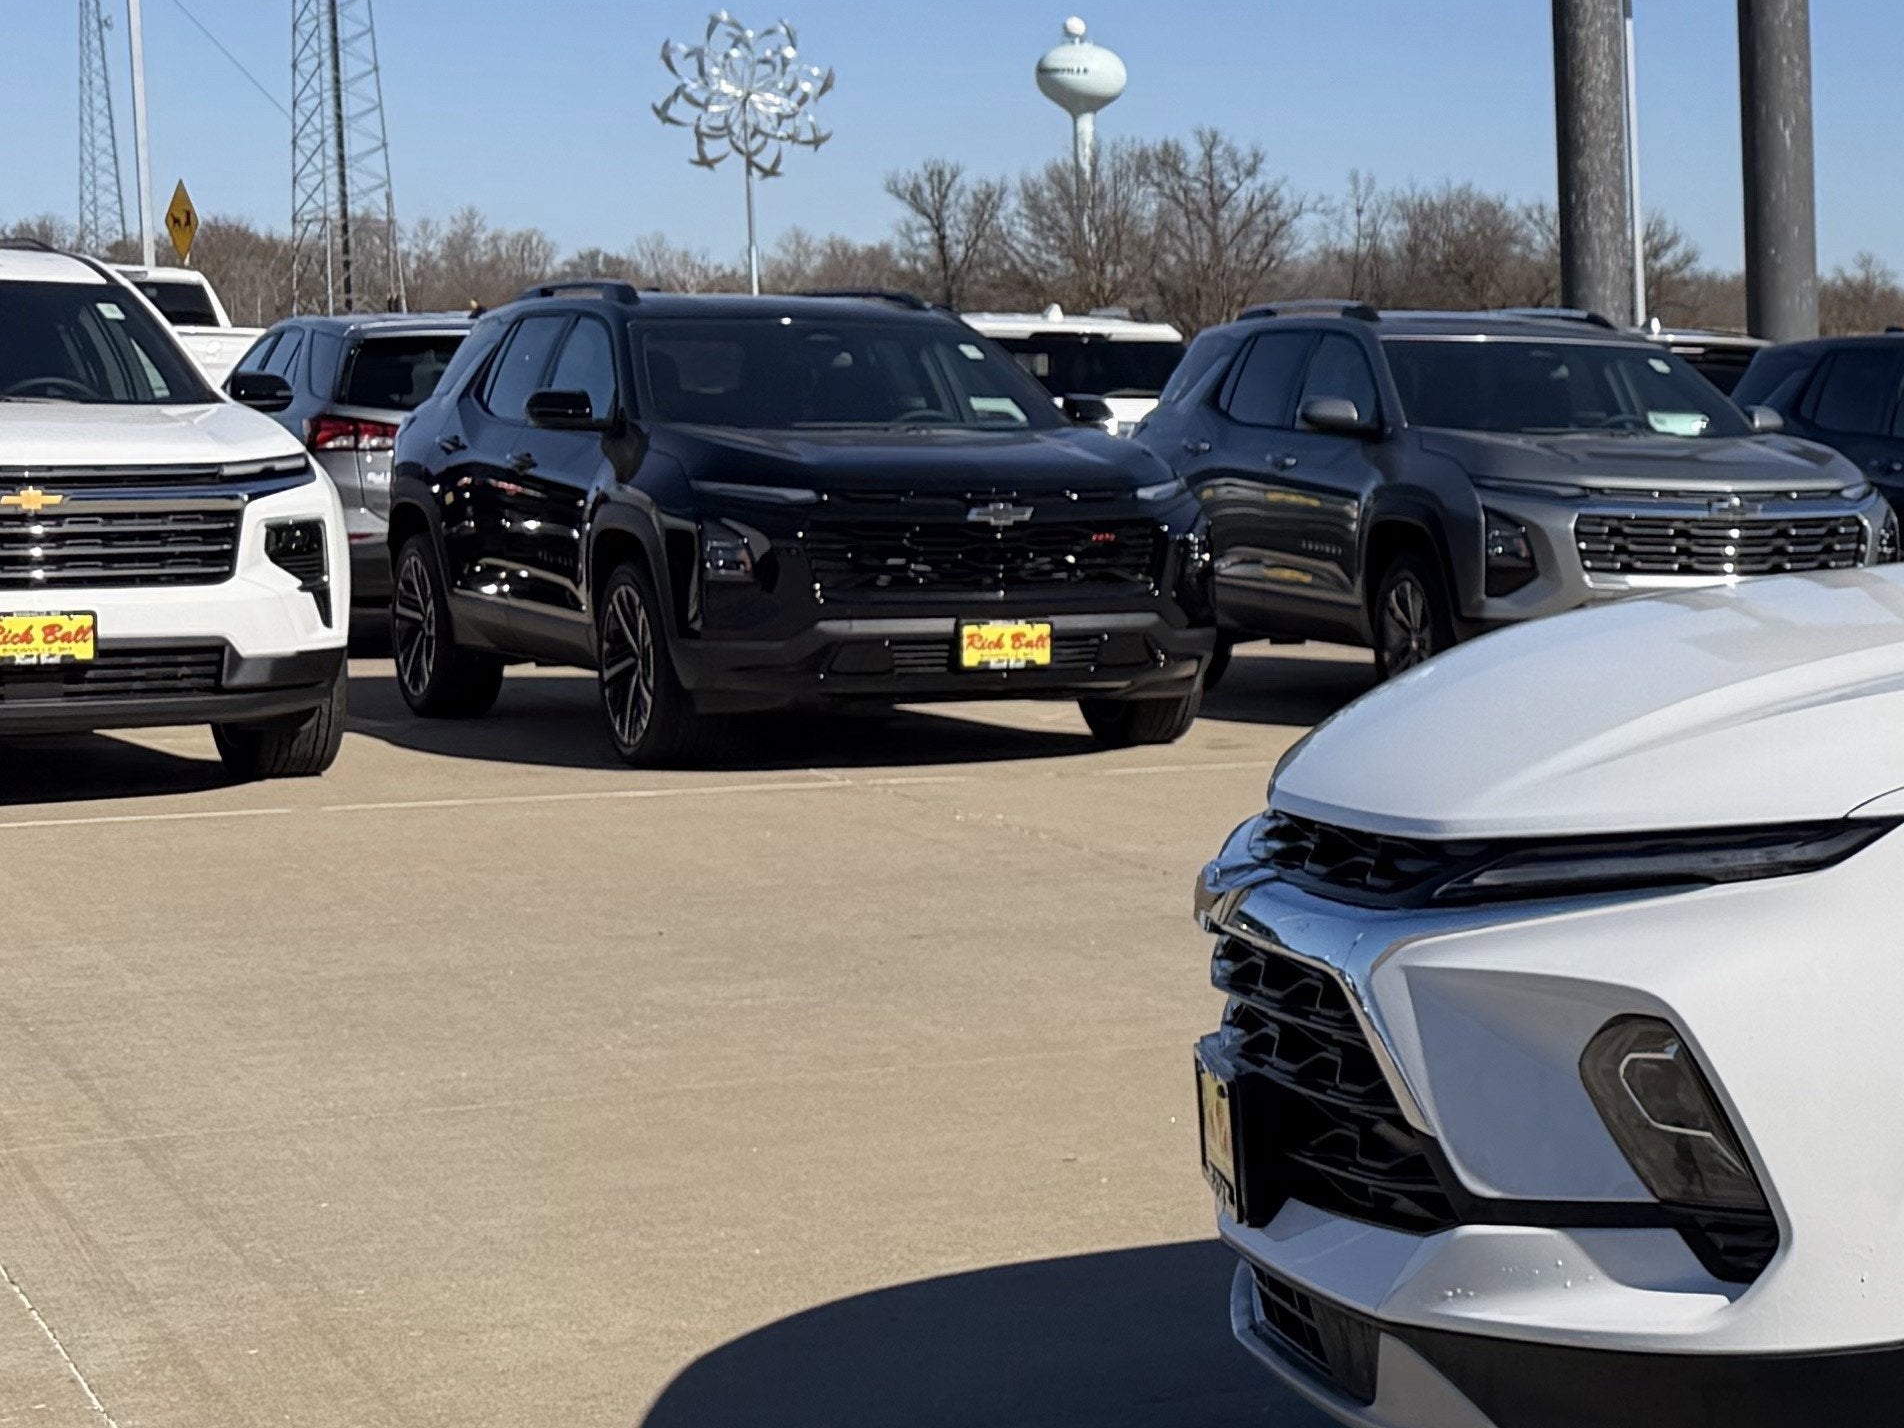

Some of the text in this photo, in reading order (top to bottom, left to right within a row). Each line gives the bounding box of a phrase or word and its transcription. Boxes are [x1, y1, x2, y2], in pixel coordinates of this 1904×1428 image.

[0, 623, 93, 645] ick Ball
[966, 631, 1049, 650] Rick Ball
